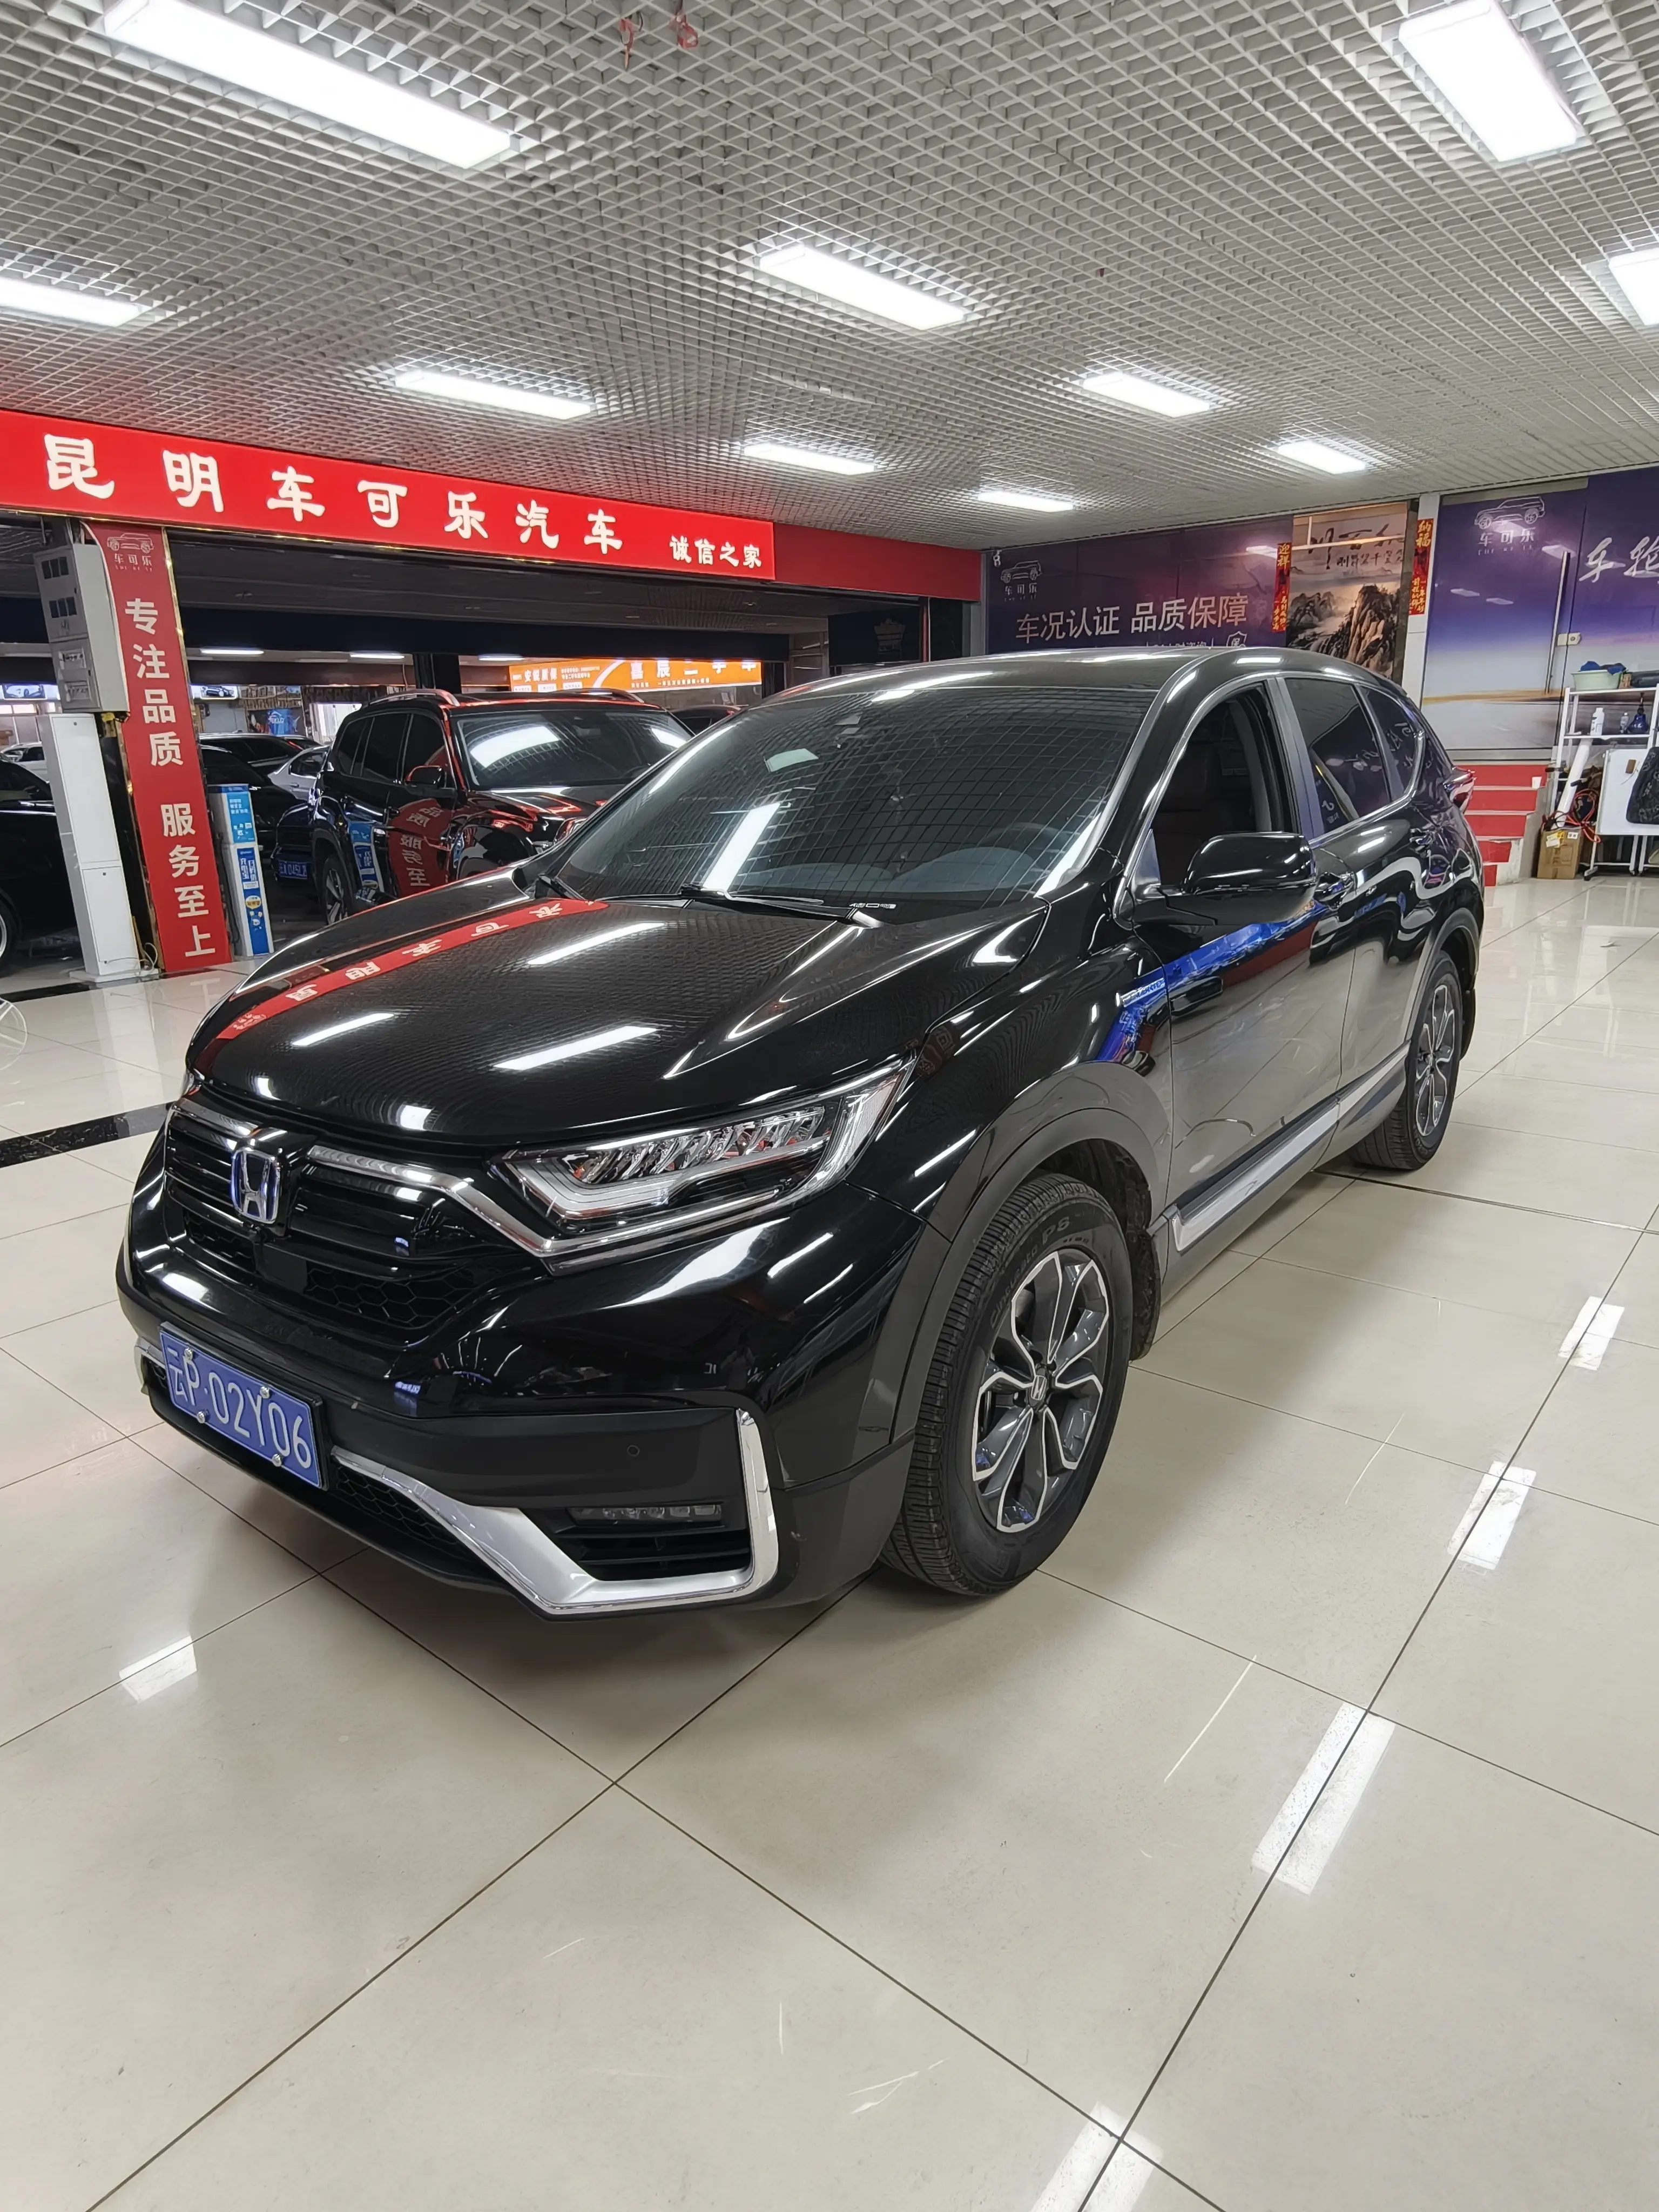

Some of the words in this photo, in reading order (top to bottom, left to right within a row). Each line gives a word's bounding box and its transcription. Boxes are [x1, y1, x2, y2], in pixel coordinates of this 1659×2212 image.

[43, 433, 623, 554] 昆明车可乐汽车
[670, 535, 762, 569] 诚信之家
[1478, 527, 1536, 547] 车可乐
[1015, 606, 1121, 644] 车况认证
[1130, 592, 1249, 634] 品质保障
[125, 597, 184, 767] 专注品质
[161, 802, 215, 957] 服务至上
